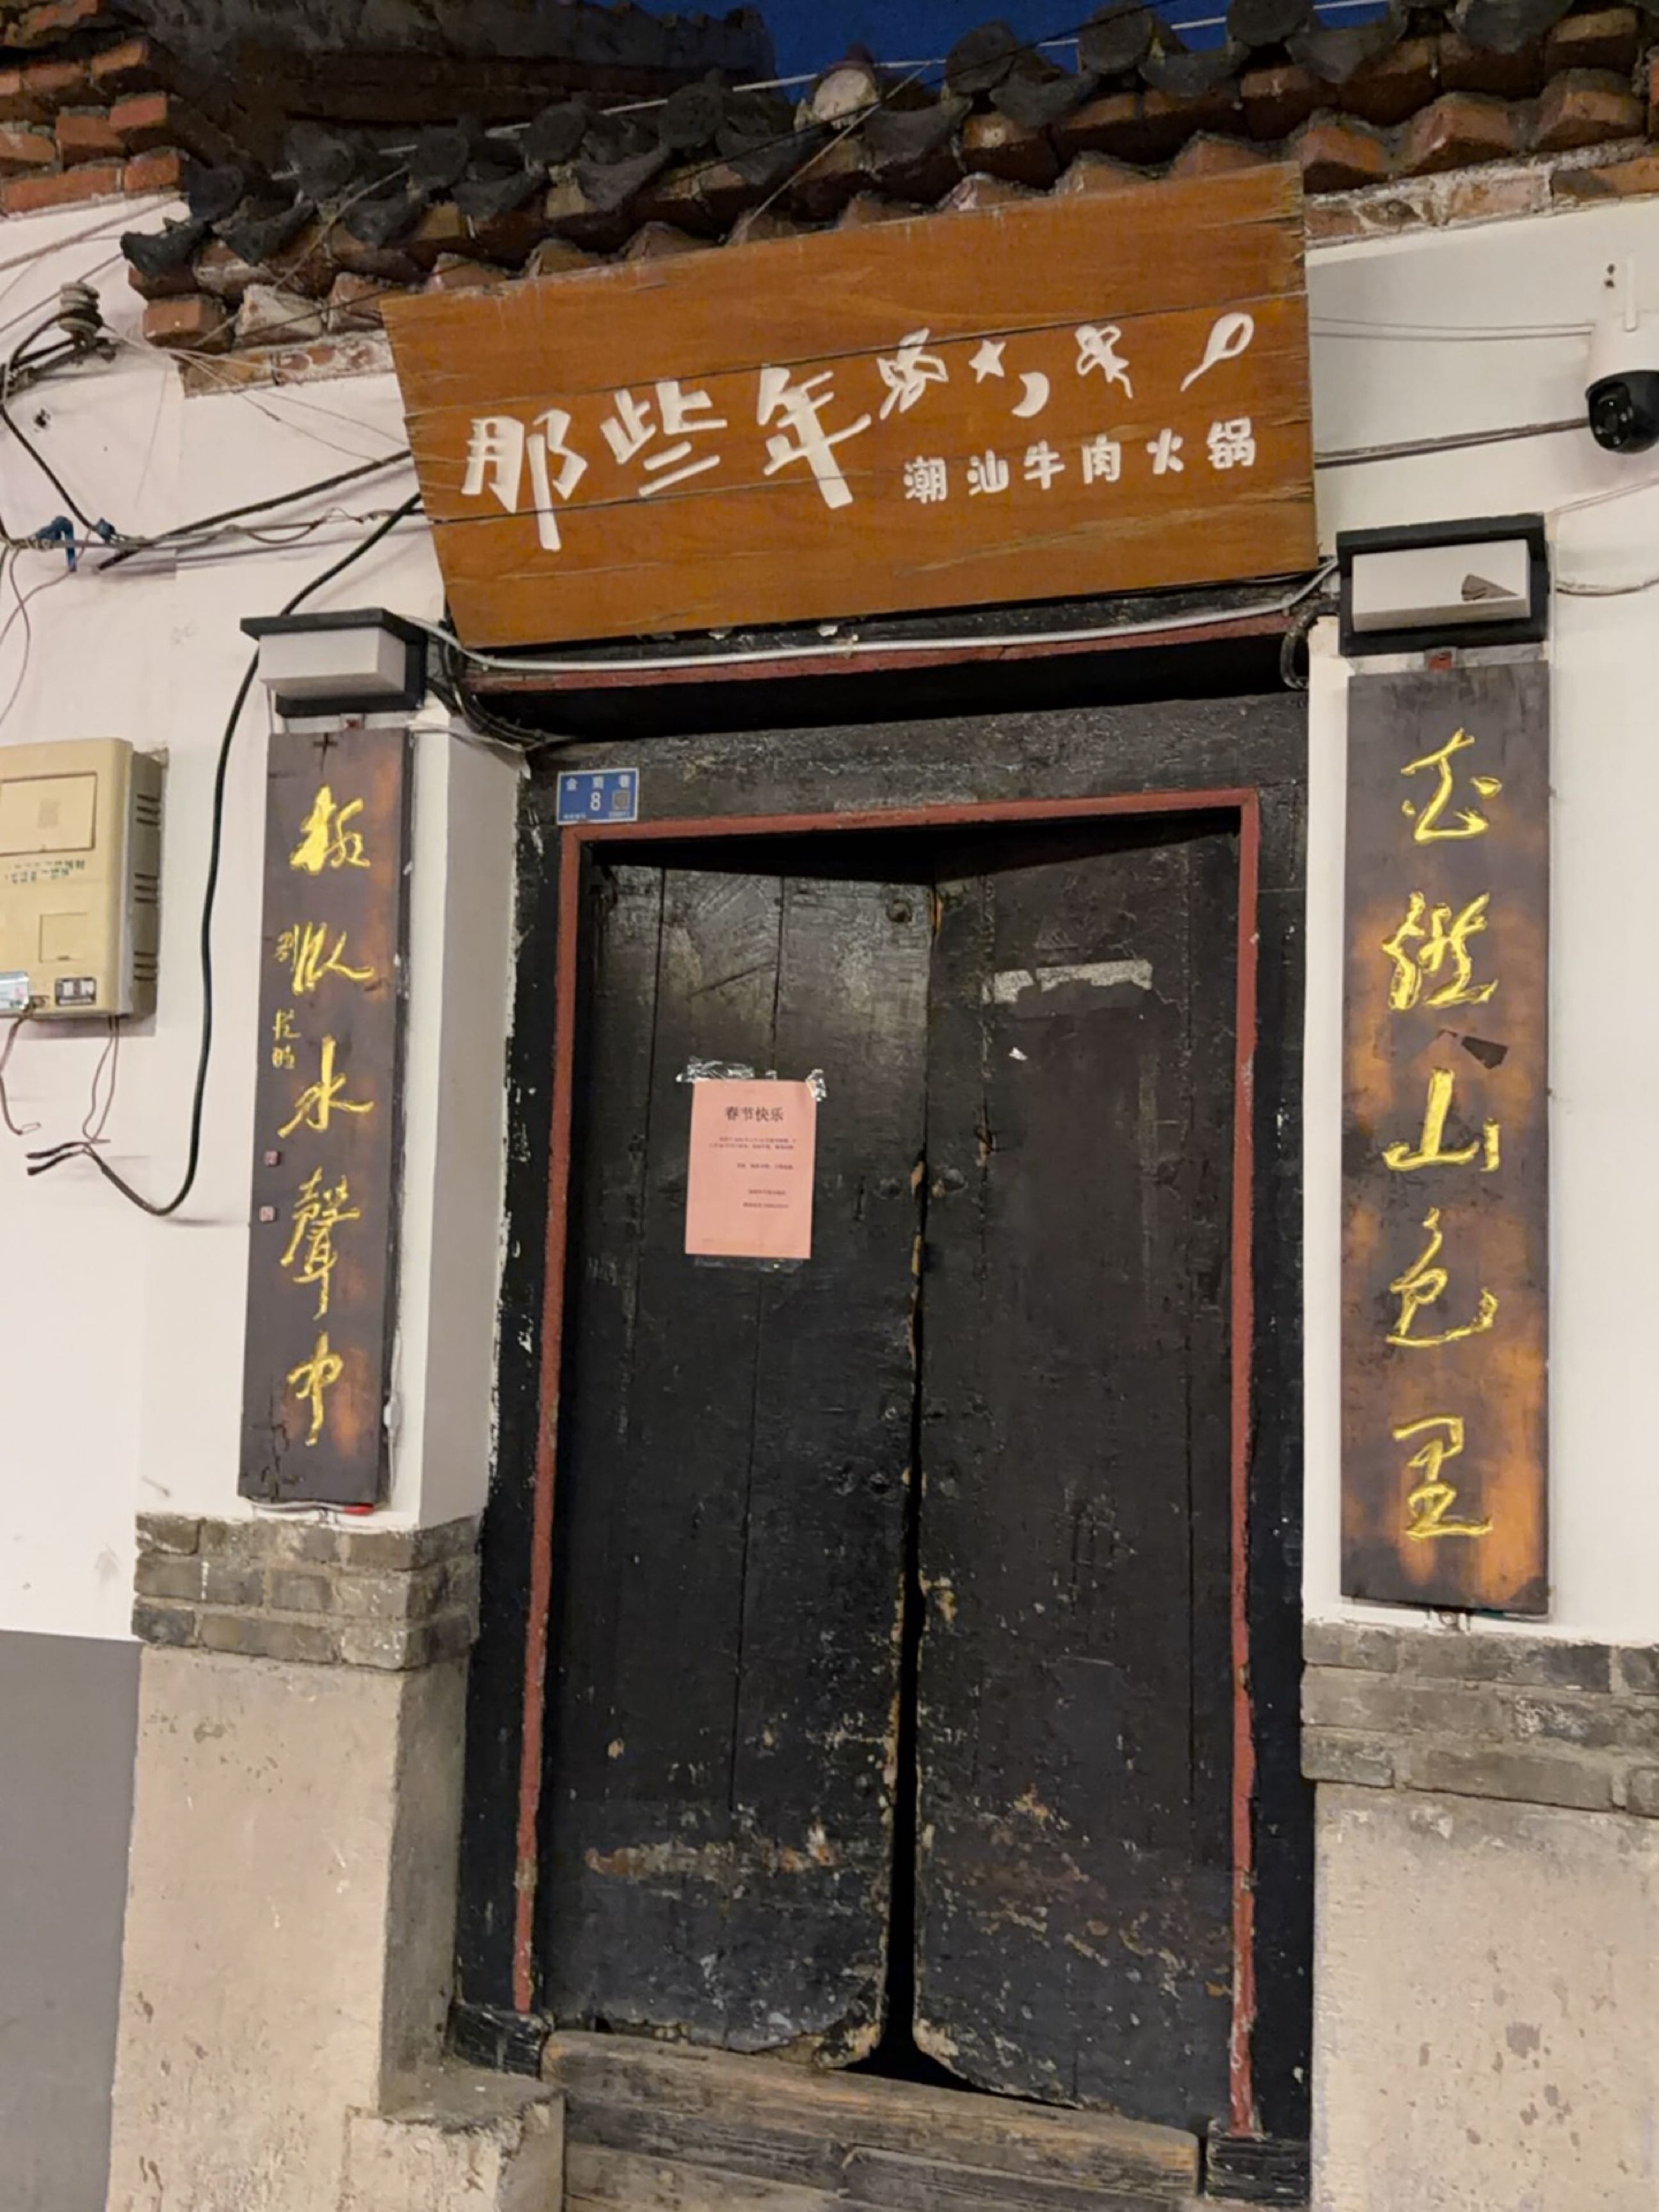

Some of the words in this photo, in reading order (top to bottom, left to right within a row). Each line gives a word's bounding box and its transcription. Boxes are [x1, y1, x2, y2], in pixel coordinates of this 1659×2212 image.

[461, 364, 871, 551] 那些年
[904, 416, 1256, 504] 潮汕牛肉火锅
[589, 791, 602, 811] 8
[726, 1106, 784, 1121] 春节快乐
